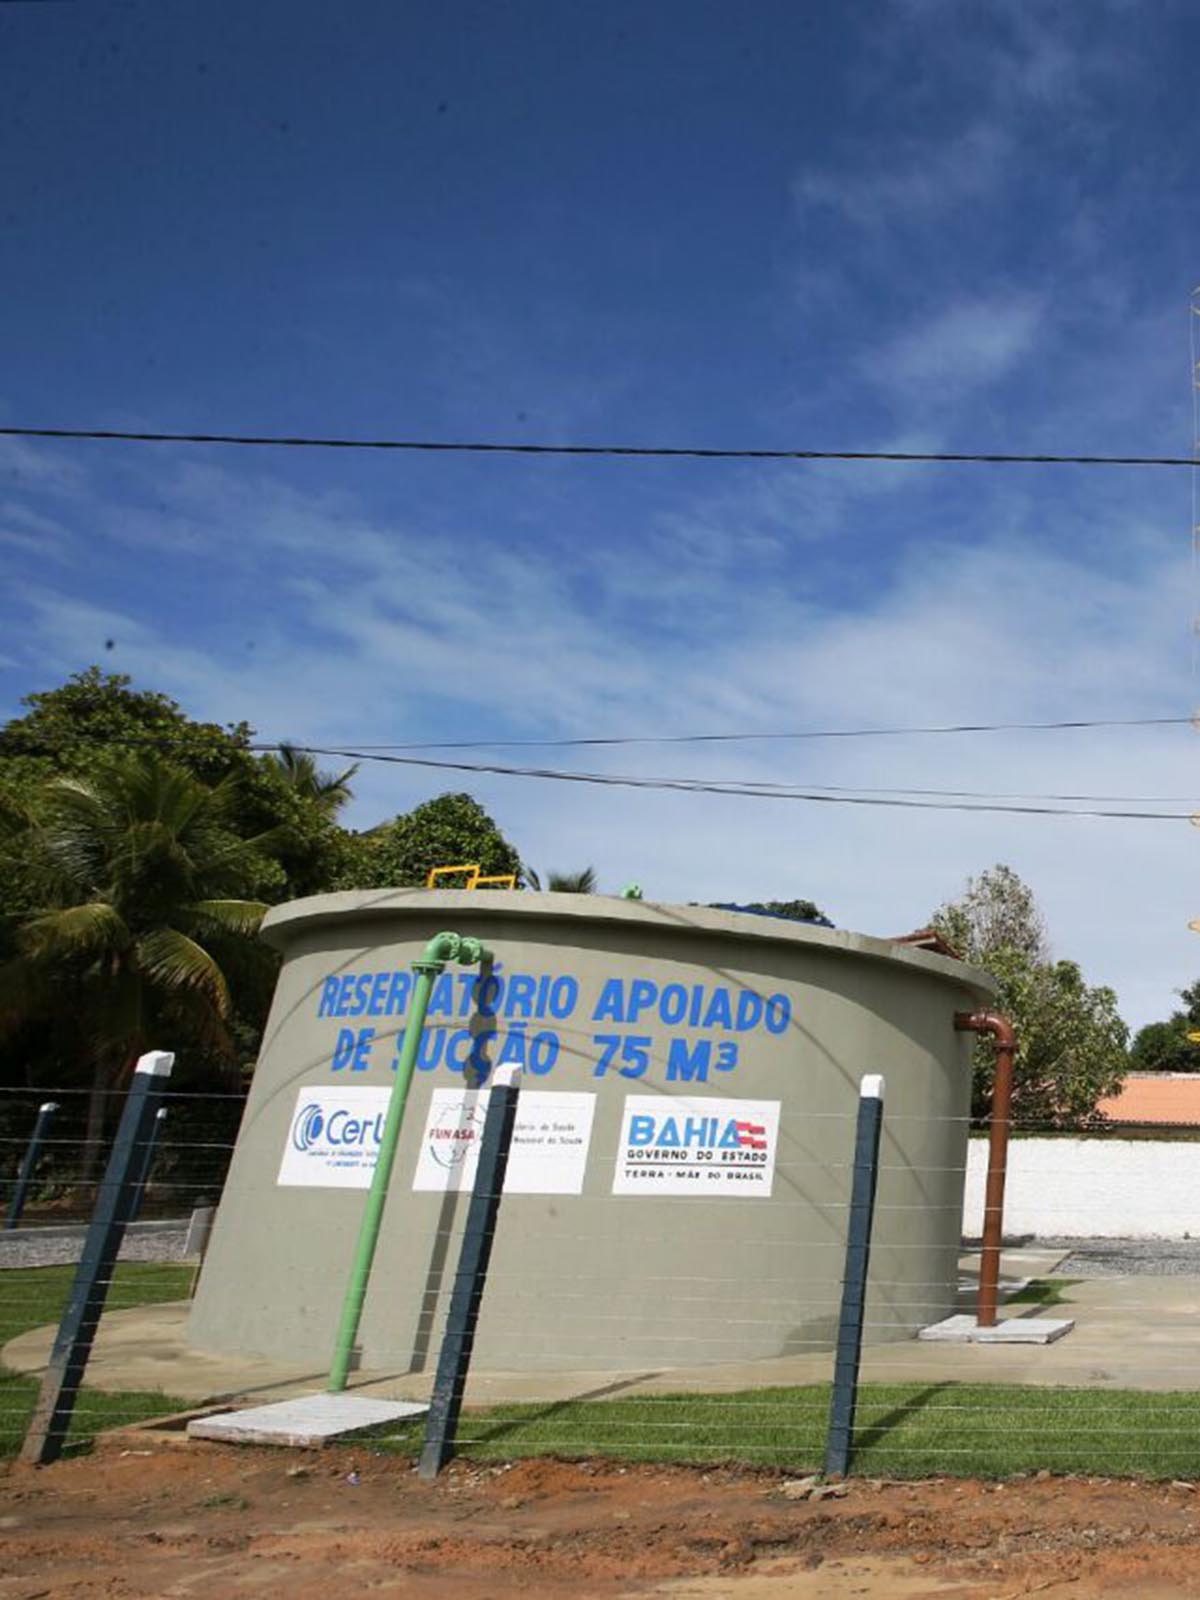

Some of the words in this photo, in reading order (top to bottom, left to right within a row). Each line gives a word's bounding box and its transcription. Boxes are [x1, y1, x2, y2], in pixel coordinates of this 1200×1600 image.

[318, 962, 578, 1019] RESERATÓRIO
[592, 977, 792, 1034] APOIADO
[331, 1027, 375, 1072] DE
[593, 1034, 652, 1079] 75
[429, 1128, 475, 1139] FUNASA
[628, 1115, 742, 1148] BAHIA
[627, 1149, 688, 1160] GOVERNO
[696, 1151, 713, 1160] DO
[722, 1151, 767, 1162] ESTADO
[727, 1172, 764, 1180] BRASIL
